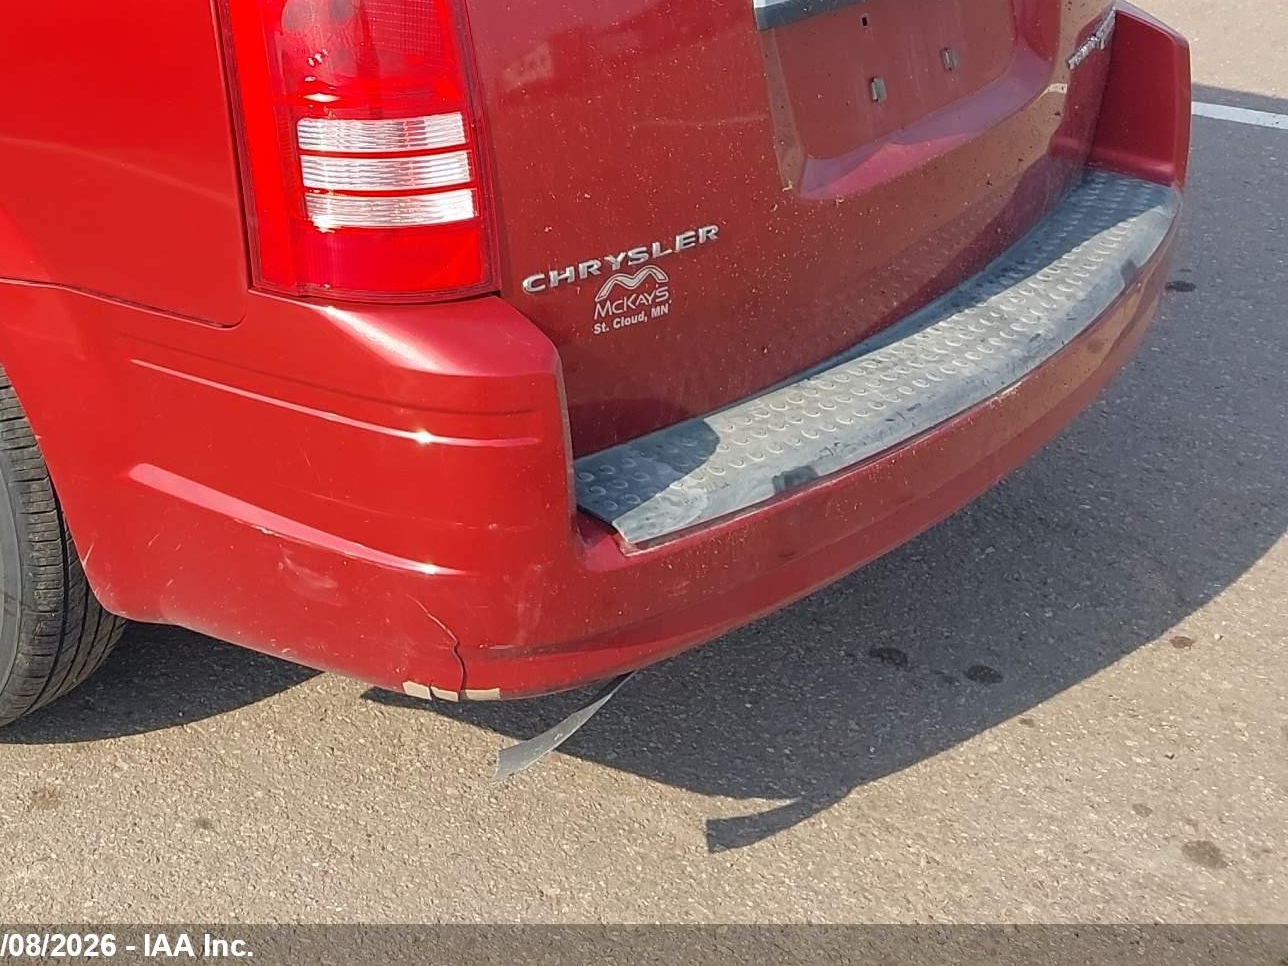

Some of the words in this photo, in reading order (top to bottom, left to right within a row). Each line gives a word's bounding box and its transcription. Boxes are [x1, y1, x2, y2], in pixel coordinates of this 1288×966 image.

[522, 224, 719, 294] CHRYSLER
[592, 323, 610, 335] St.
[613, 312, 648, 330] Cloud,
[650, 303, 669, 319] MN
